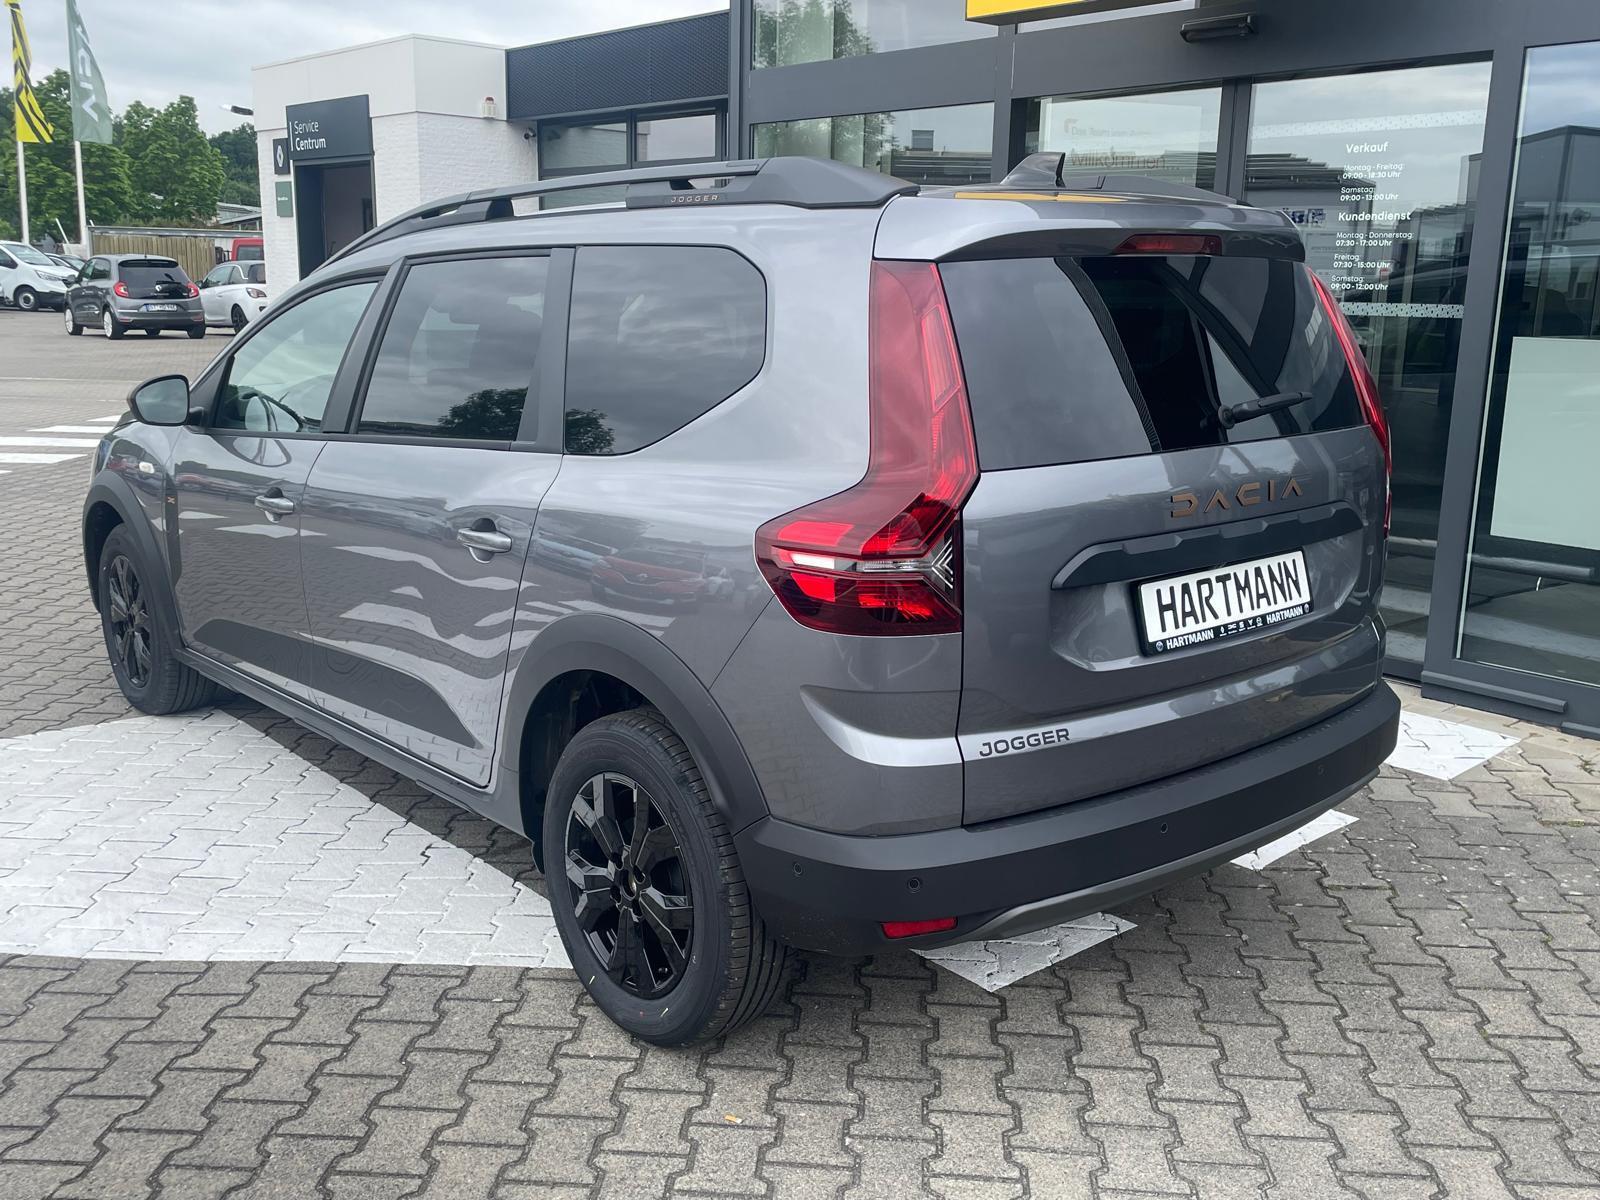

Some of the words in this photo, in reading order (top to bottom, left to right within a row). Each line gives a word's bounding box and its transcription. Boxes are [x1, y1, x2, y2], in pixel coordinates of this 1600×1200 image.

[294, 120, 318, 134] Service
[296, 137, 326, 151] Centrum
[1346, 142, 1389, 153] Verkauf
[1338, 211, 1411, 221] Kundendienst
[1170, 478, 1304, 518] DACIA
[1156, 558, 1302, 633] HARTMANN
[1166, 628, 1214, 650] HARTMANN
[1266, 606, 1304, 624] HARTMANN
[979, 728, 1070, 757] JOGGER
